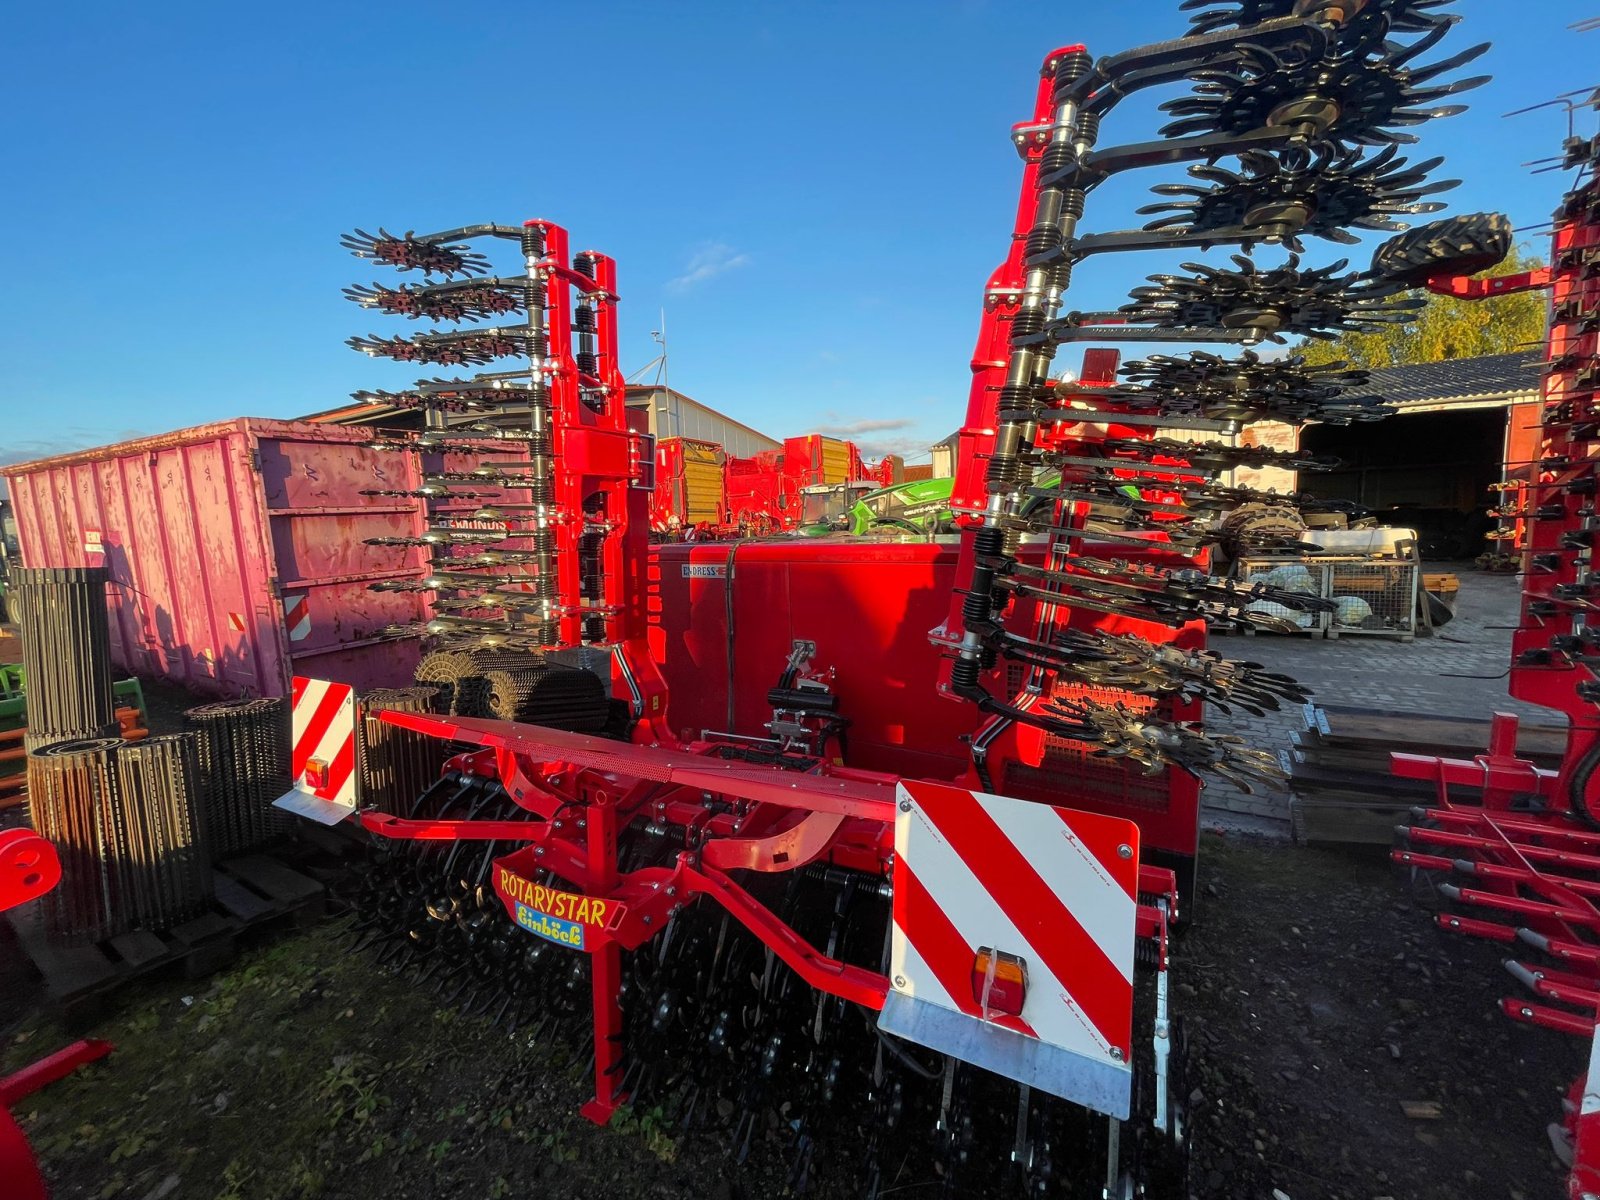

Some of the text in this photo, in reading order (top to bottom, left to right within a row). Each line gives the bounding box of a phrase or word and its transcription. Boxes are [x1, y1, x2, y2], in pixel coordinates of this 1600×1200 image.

[683, 566, 716, 576] ENDRESS
[500, 869, 606, 928] ROTARYSTAR
[517, 905, 582, 946] Einböck
